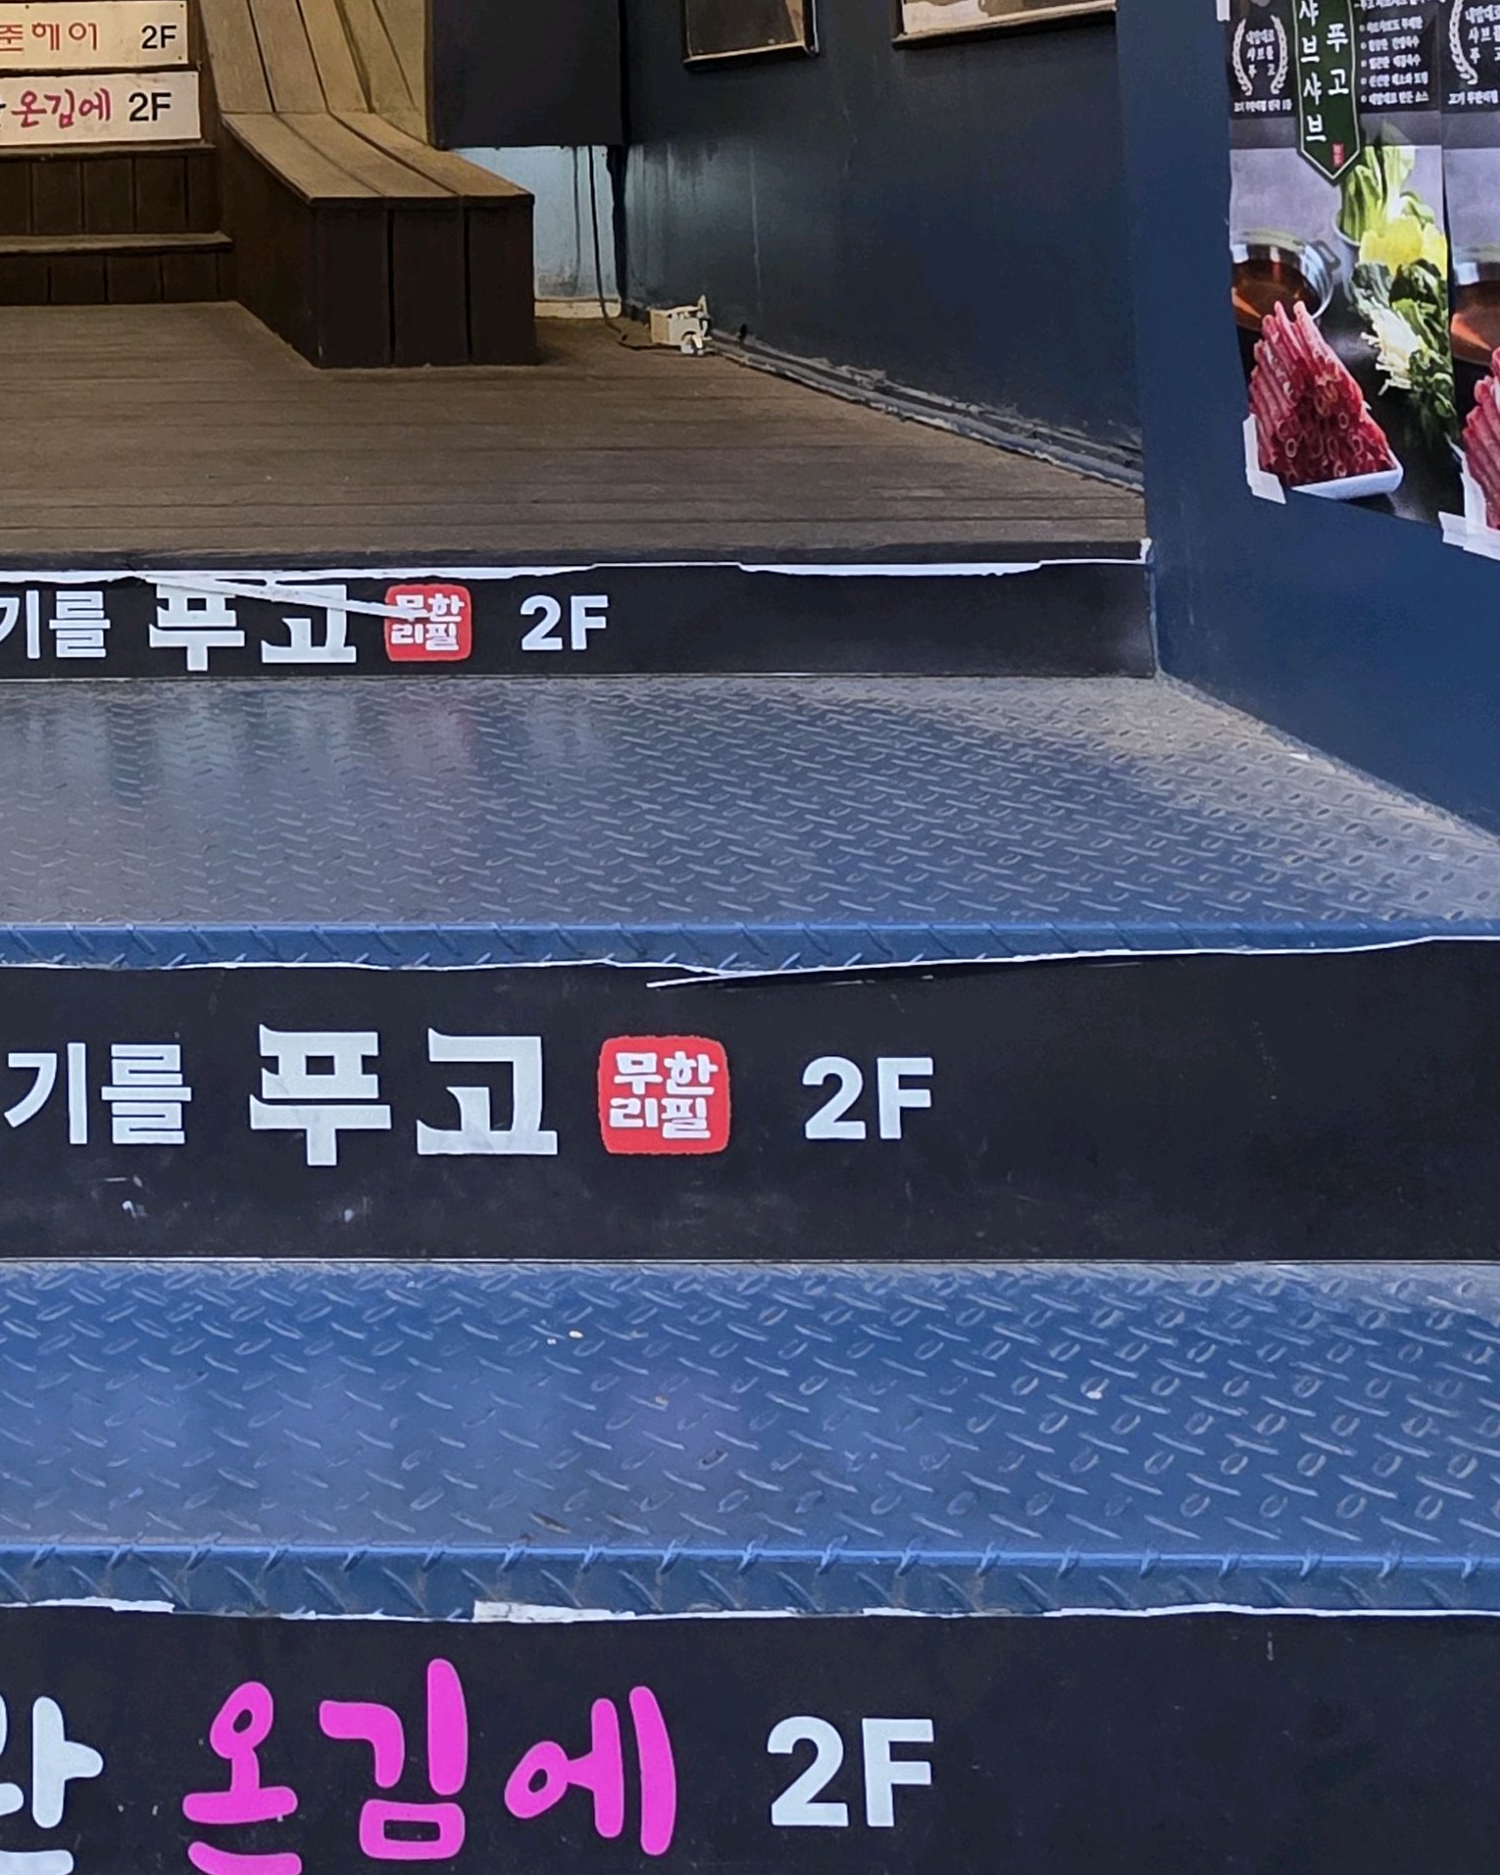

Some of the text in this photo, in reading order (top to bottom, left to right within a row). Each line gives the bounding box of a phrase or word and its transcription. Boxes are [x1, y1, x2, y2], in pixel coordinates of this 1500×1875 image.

[140, 24, 178, 50] 2F
[1326, 22, 1349, 96] 푸고
[10, 88, 112, 129] 온김에
[127, 91, 173, 122] 2F
[148, 582, 358, 673] 푸고
[390, 622, 461, 652] 리필
[519, 593, 609, 652] 2F
[249, 1023, 558, 1167] 푸고
[613, 1050, 719, 1098] 무한
[801, 1055, 933, 1140] 2F
[608, 1094, 712, 1140] 리필
[182, 1657, 677, 1875] 온김에
[765, 1714, 936, 1827] 2F
